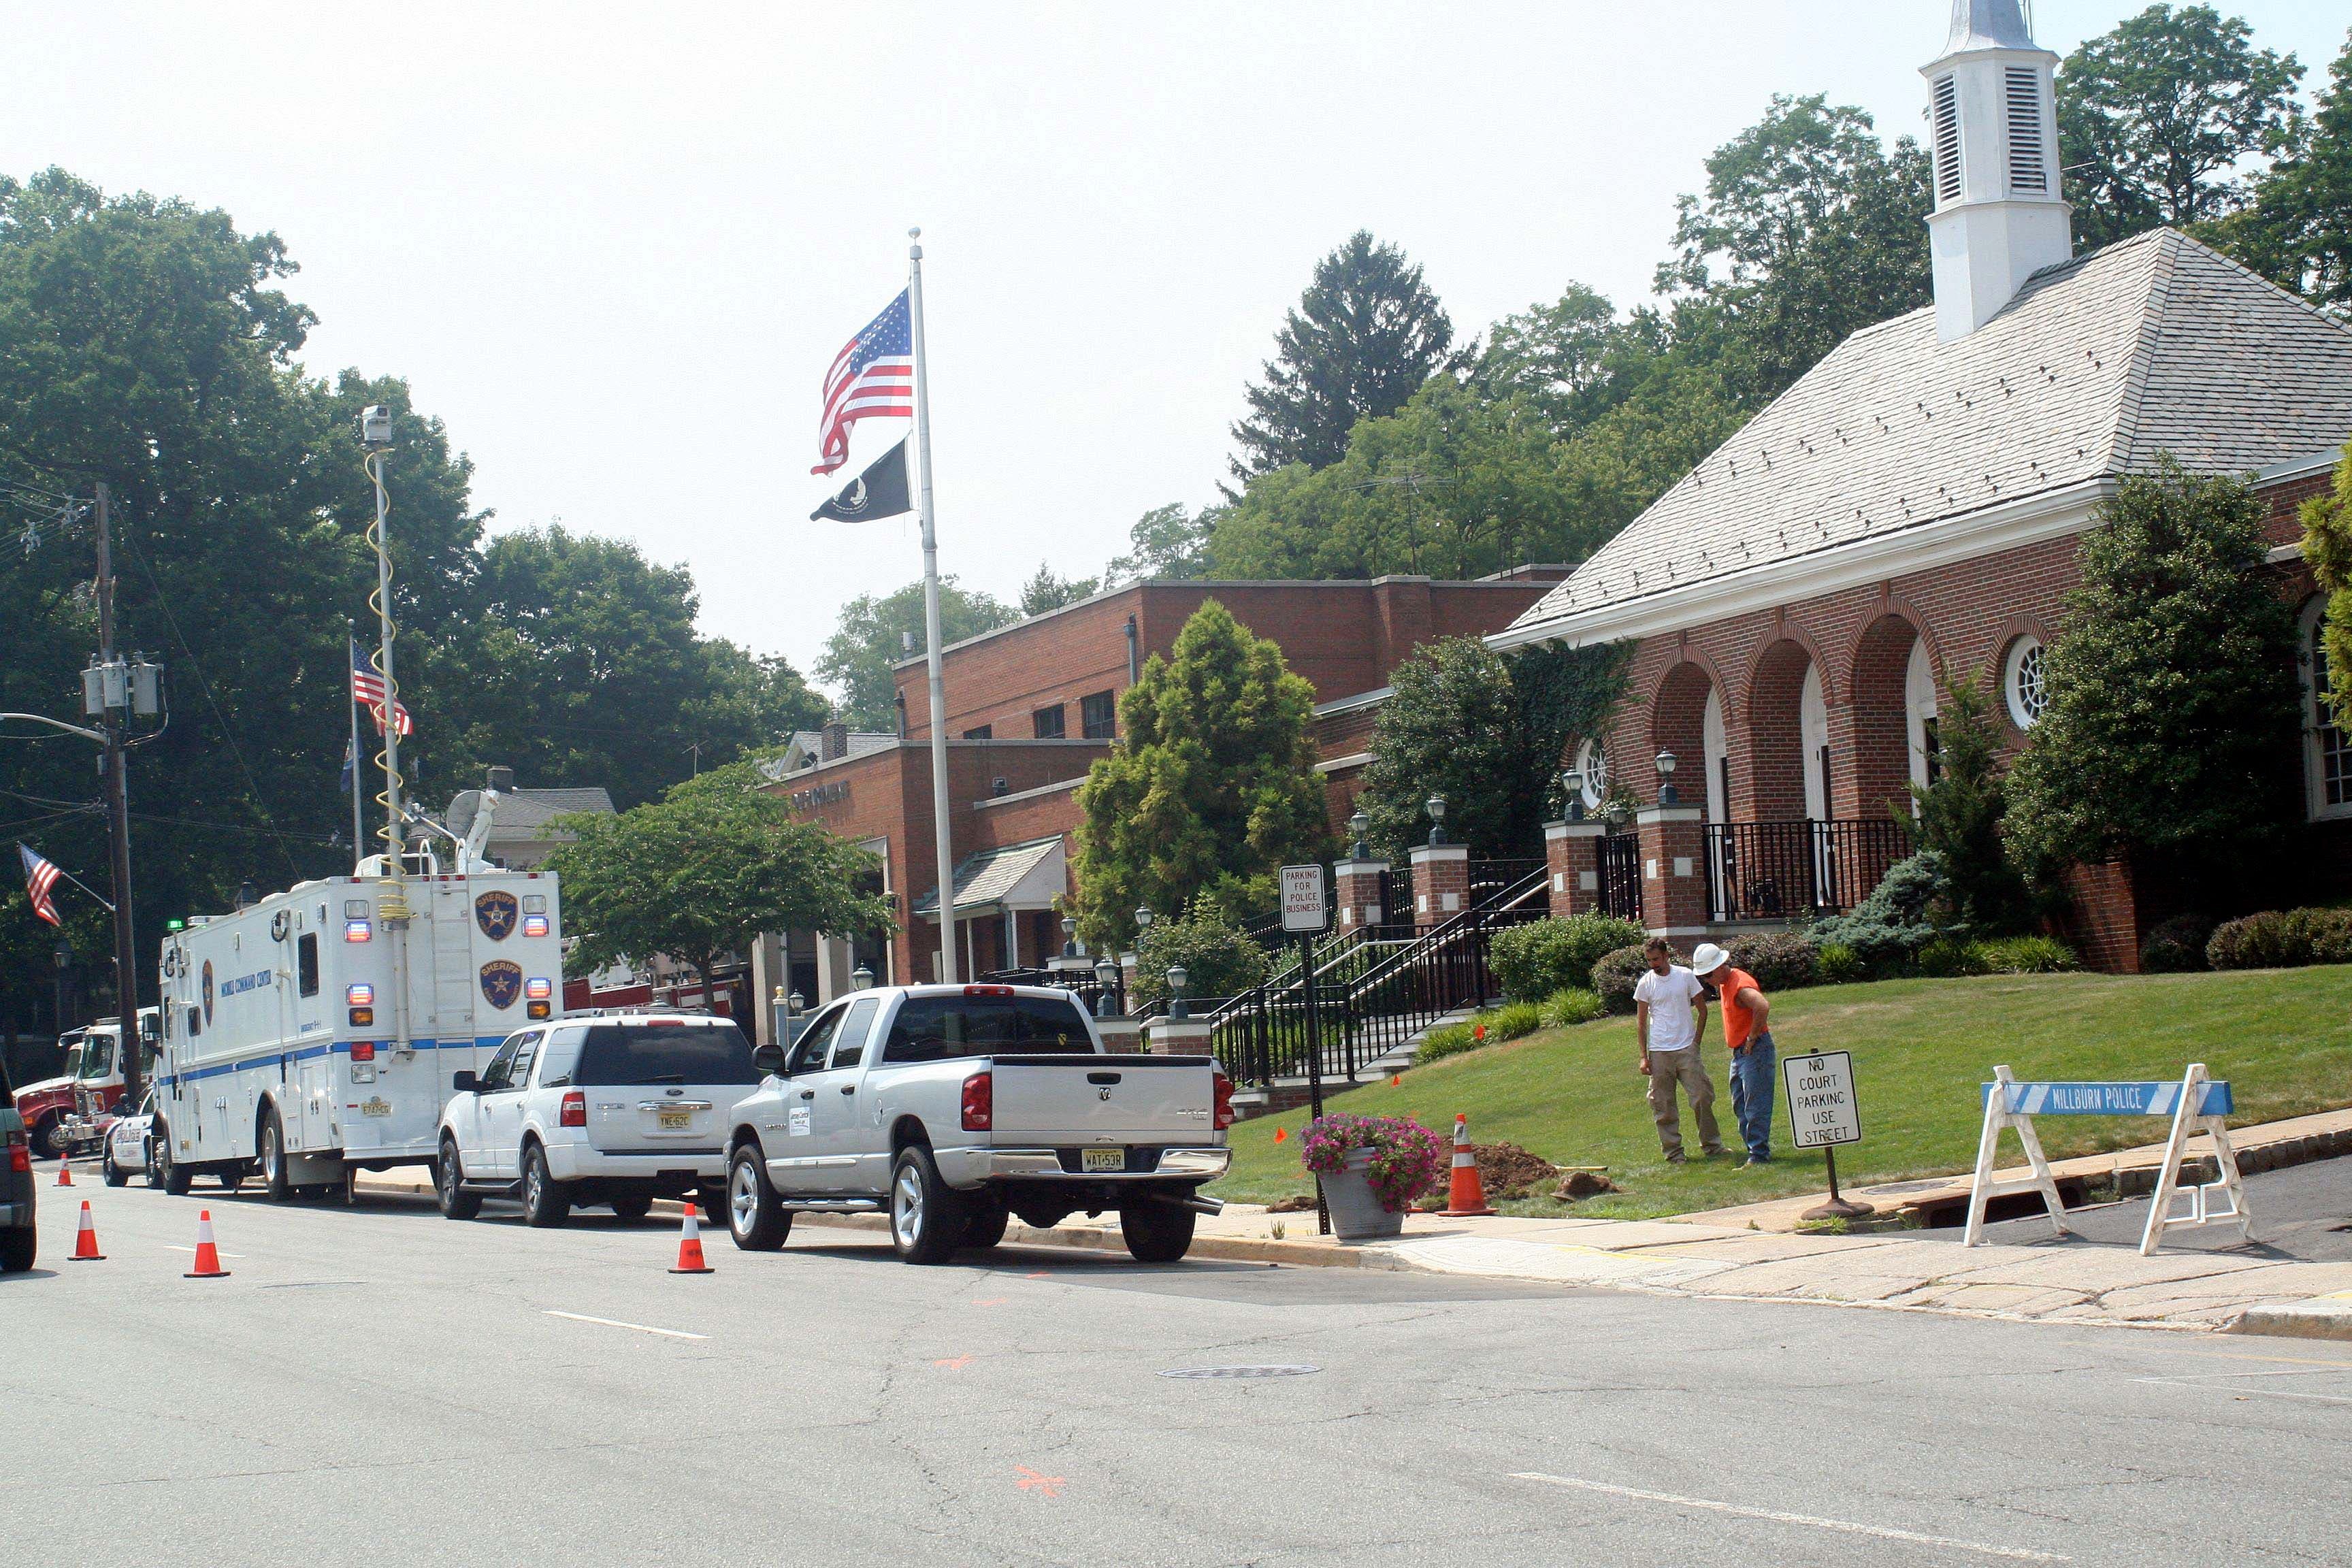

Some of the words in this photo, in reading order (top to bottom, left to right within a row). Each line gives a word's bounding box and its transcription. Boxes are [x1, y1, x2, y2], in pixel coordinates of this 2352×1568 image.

[1286, 870, 1318, 880] PARKING
[1294, 882, 1311, 890] FOR
[477, 893, 515, 907] SHERIFF
[1290, 892, 1318, 902] POLICE
[1286, 903, 1321, 913] BUSINESS
[481, 962, 521, 977] SHERIFF
[1808, 1058, 1825, 1073] NO
[1799, 1074, 1838, 1091] COURT
[2053, 1088, 2102, 1109] MILLBURN
[2105, 1088, 2142, 1109] POLICE
[1812, 1110, 1836, 1125] USE
[116, 1128, 141, 1144] POLICE
[1804, 1126, 1848, 1143] STREET
